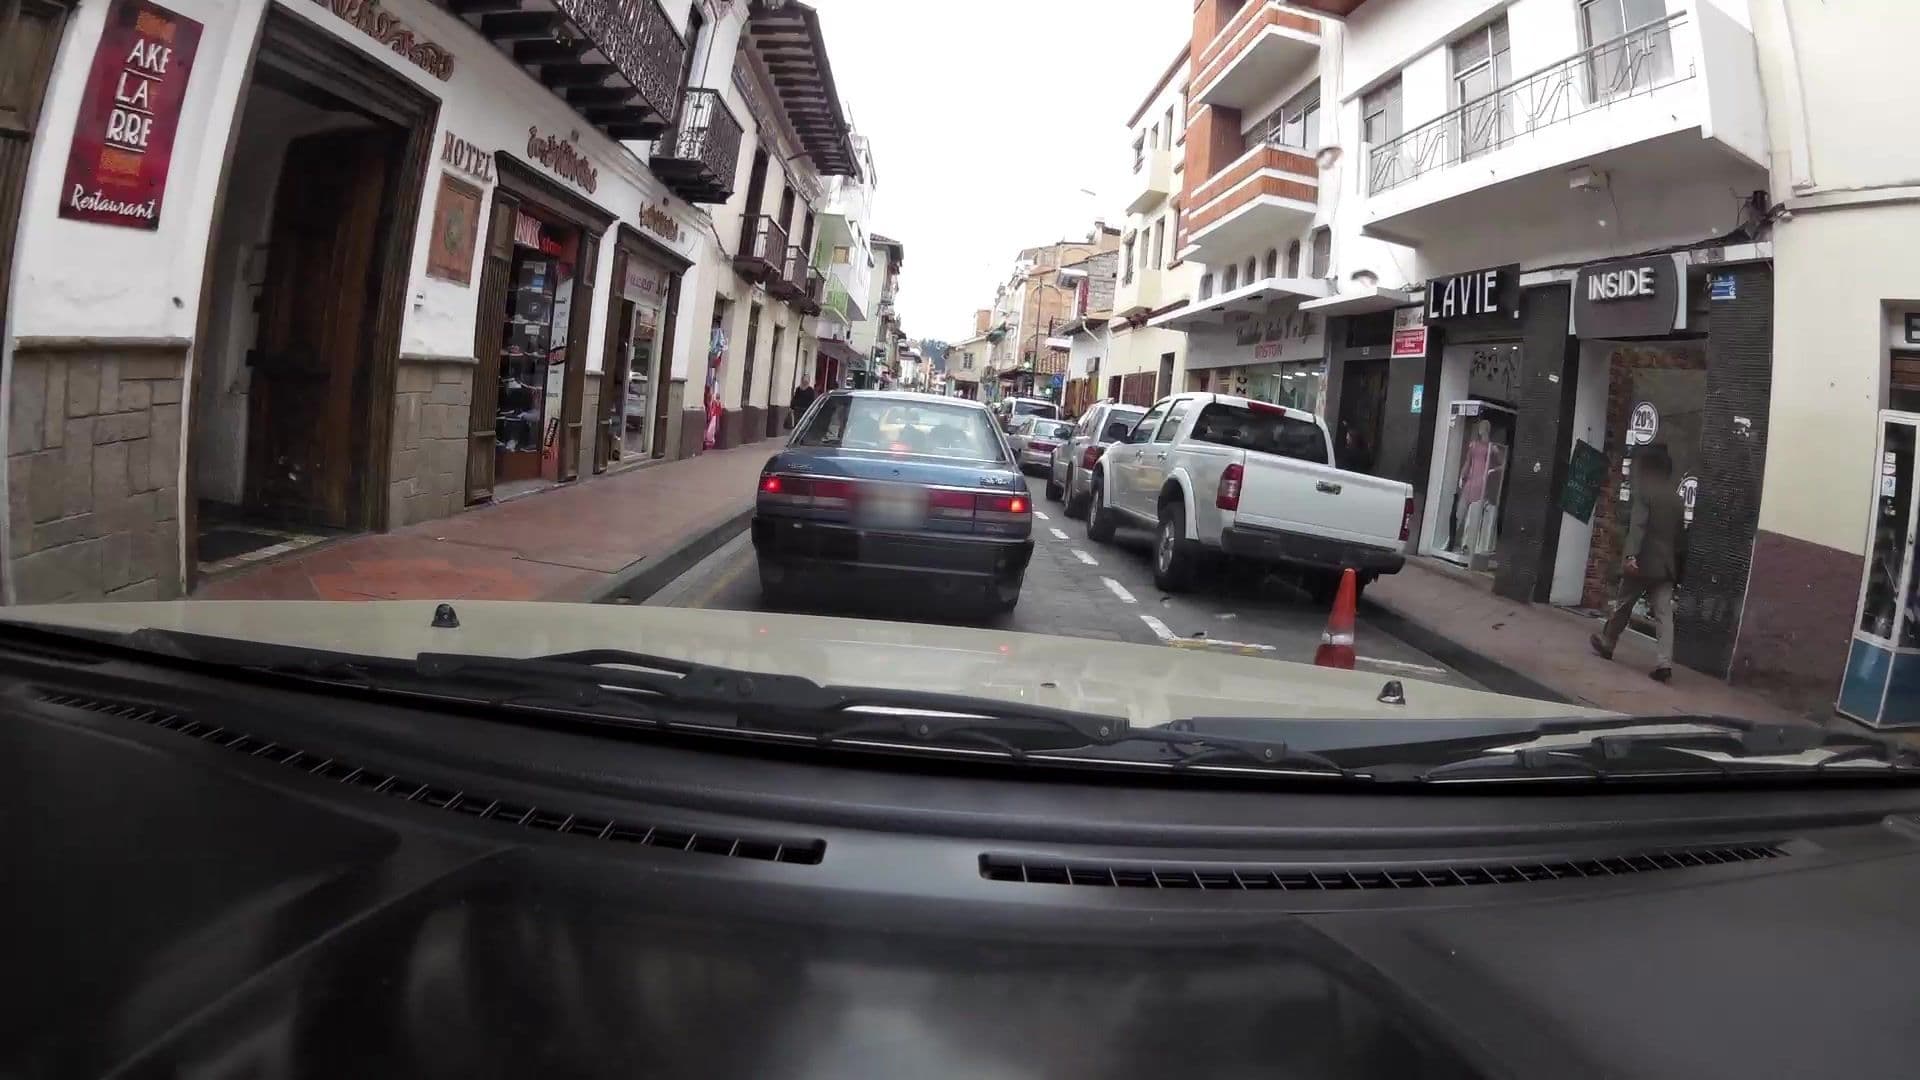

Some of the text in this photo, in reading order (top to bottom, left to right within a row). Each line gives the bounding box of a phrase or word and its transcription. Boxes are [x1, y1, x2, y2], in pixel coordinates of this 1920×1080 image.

[127, 38, 172, 74] AKE
[114, 71, 149, 109] LA
[105, 109, 153, 147] RRE
[441, 130, 495, 183] HOTEL
[71, 183, 156, 219] Restaurant
[1588, 267, 1655, 301] INSIDE
[1635, 410, 1654, 429] 20%
